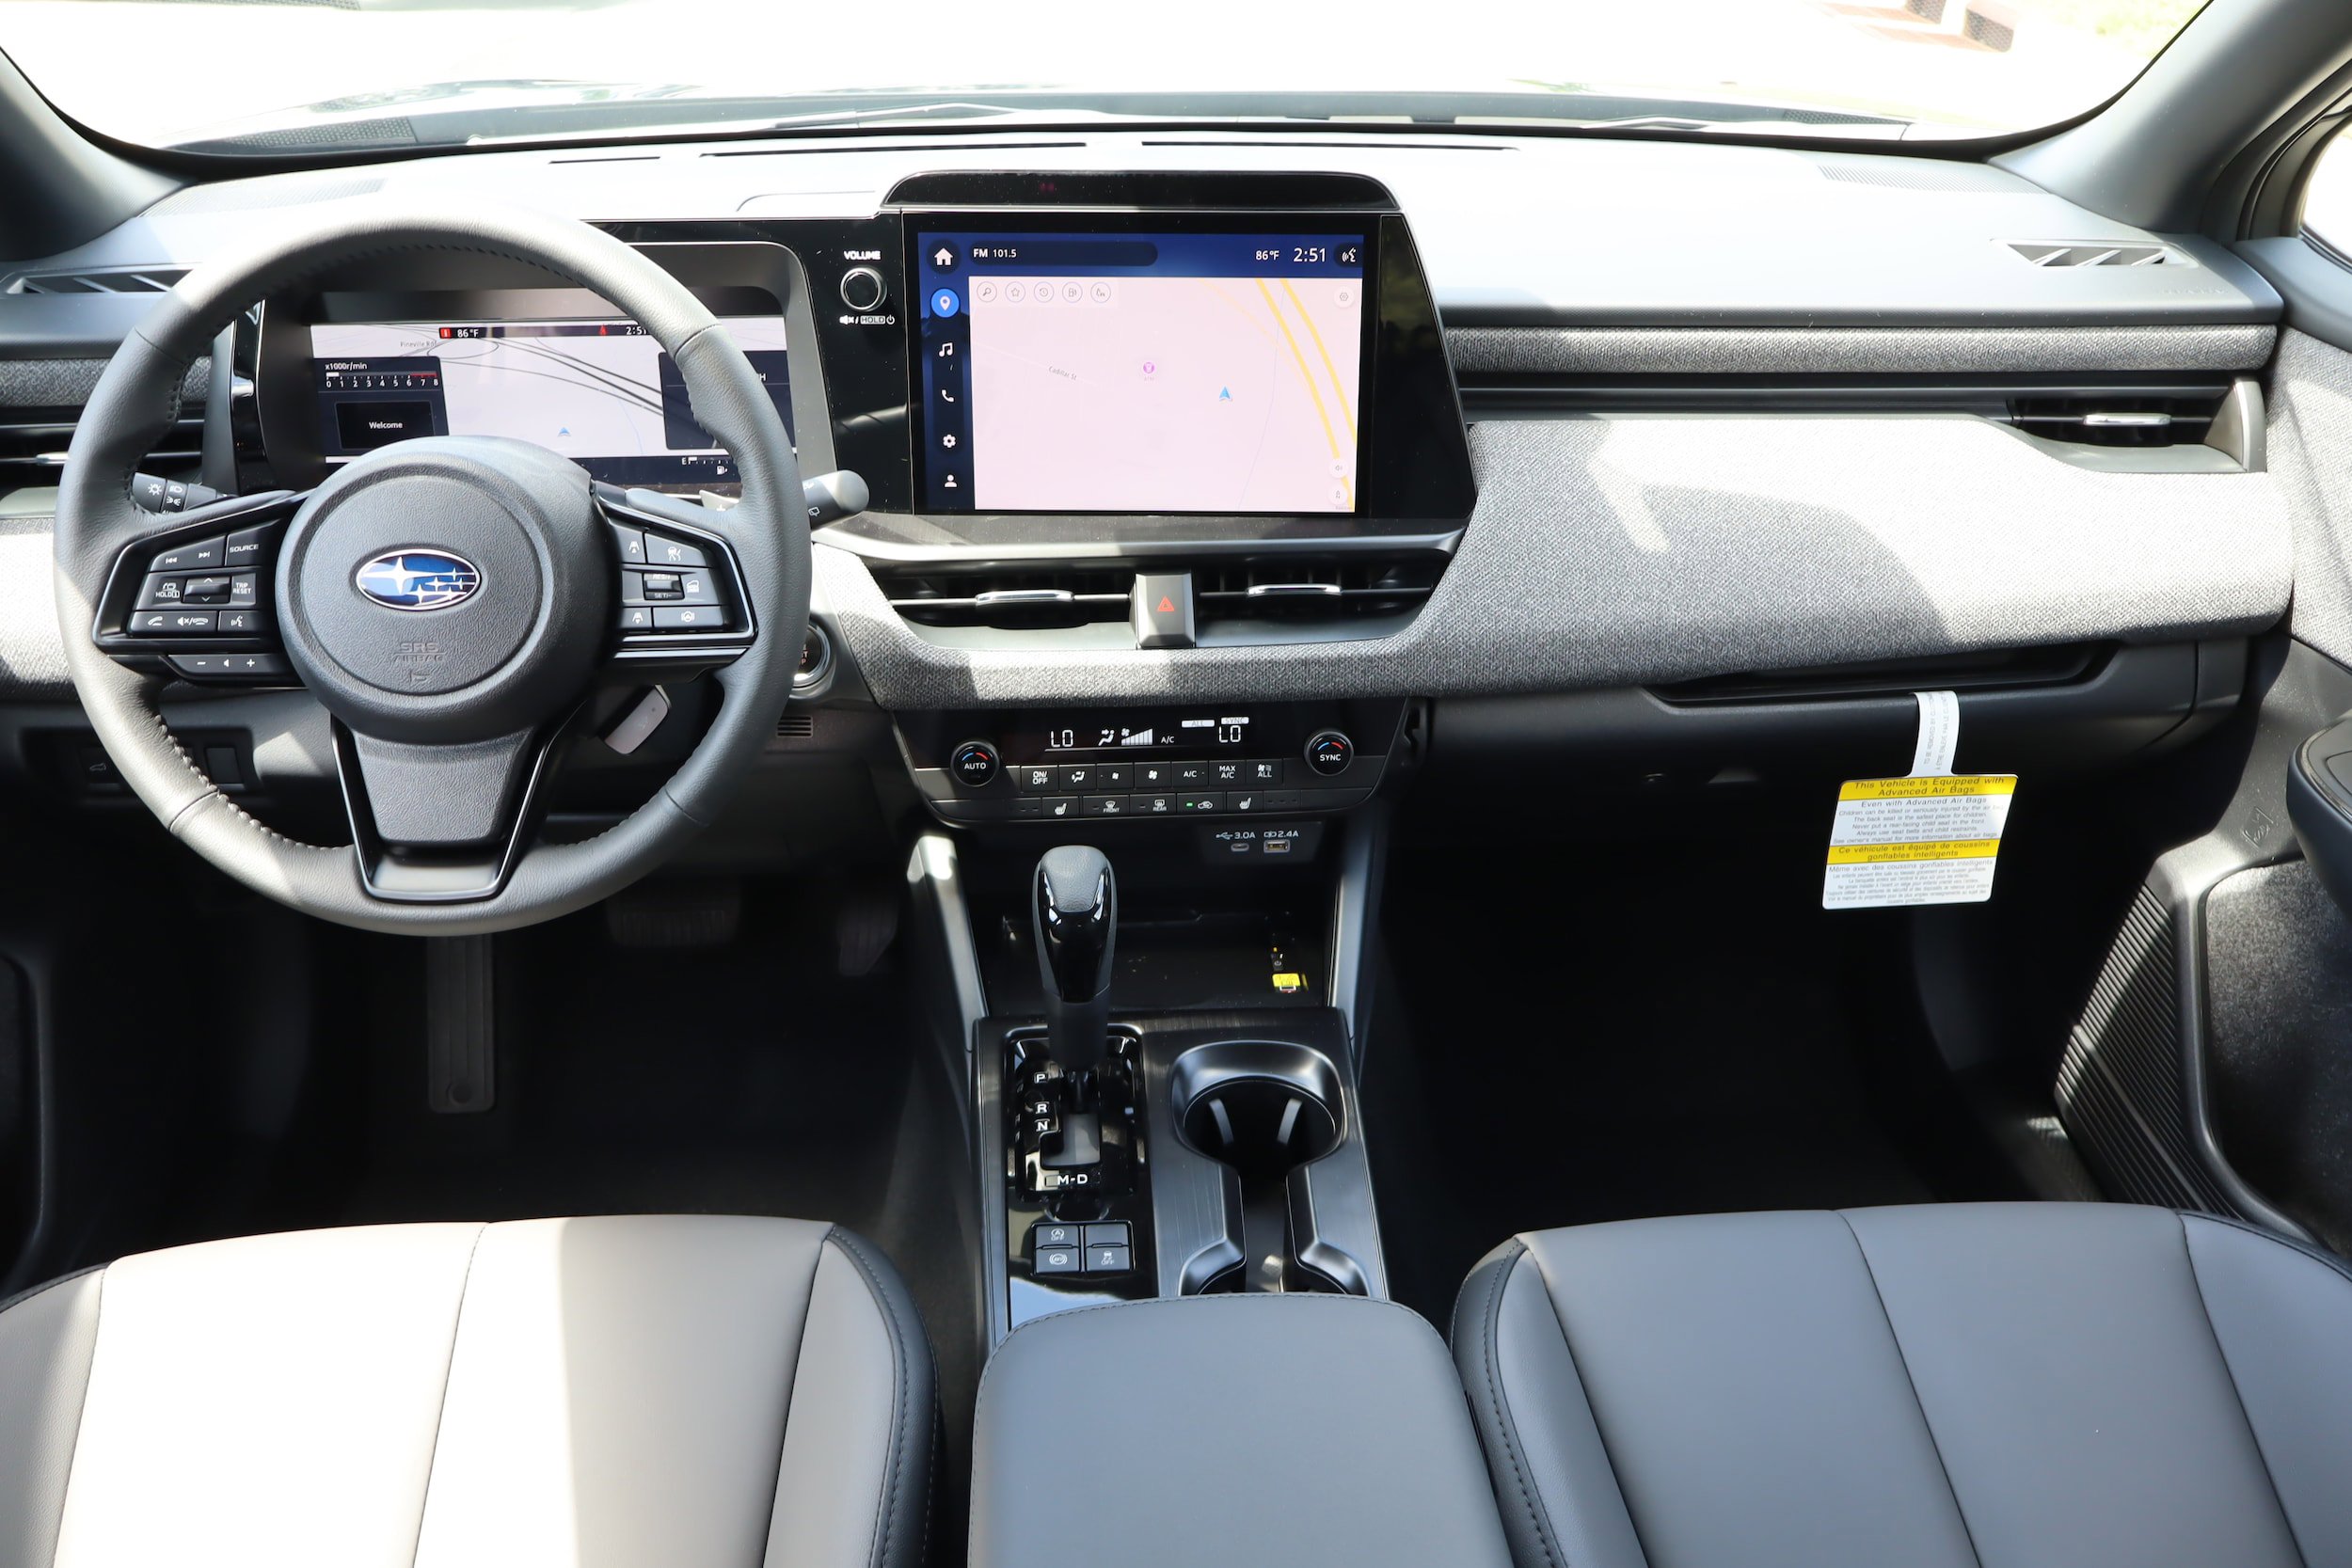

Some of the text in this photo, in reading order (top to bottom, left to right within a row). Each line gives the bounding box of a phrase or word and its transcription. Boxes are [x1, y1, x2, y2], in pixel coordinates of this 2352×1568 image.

[843, 251, 881, 260] VOLUME
[973, 248, 1017, 259] FM 101.5
[1255, 250, 1280, 261] 86°F
[1294, 247, 1327, 263] 2:51
[229, 543, 259, 553] SOURCE
[399, 642, 439, 653] SRS
[1050, 725, 1241, 747] LO A/C LO
[1319, 753, 1342, 762] SYNC
[964, 761, 987, 770] AUTO
[1933, 778, 1980, 787] Equipped
[1878, 788, 1928, 796] Advanced
[1950, 786, 1975, 795] Bags
[1234, 831, 1255, 839] 3.0A
[1867, 850, 1958, 862] gonflables intelligents
[1920, 861, 1954, 869] gonflables
[1036, 1073, 1046, 1083] P
[1037, 1103, 1047, 1113] R
[1037, 1121, 1048, 1131] N
